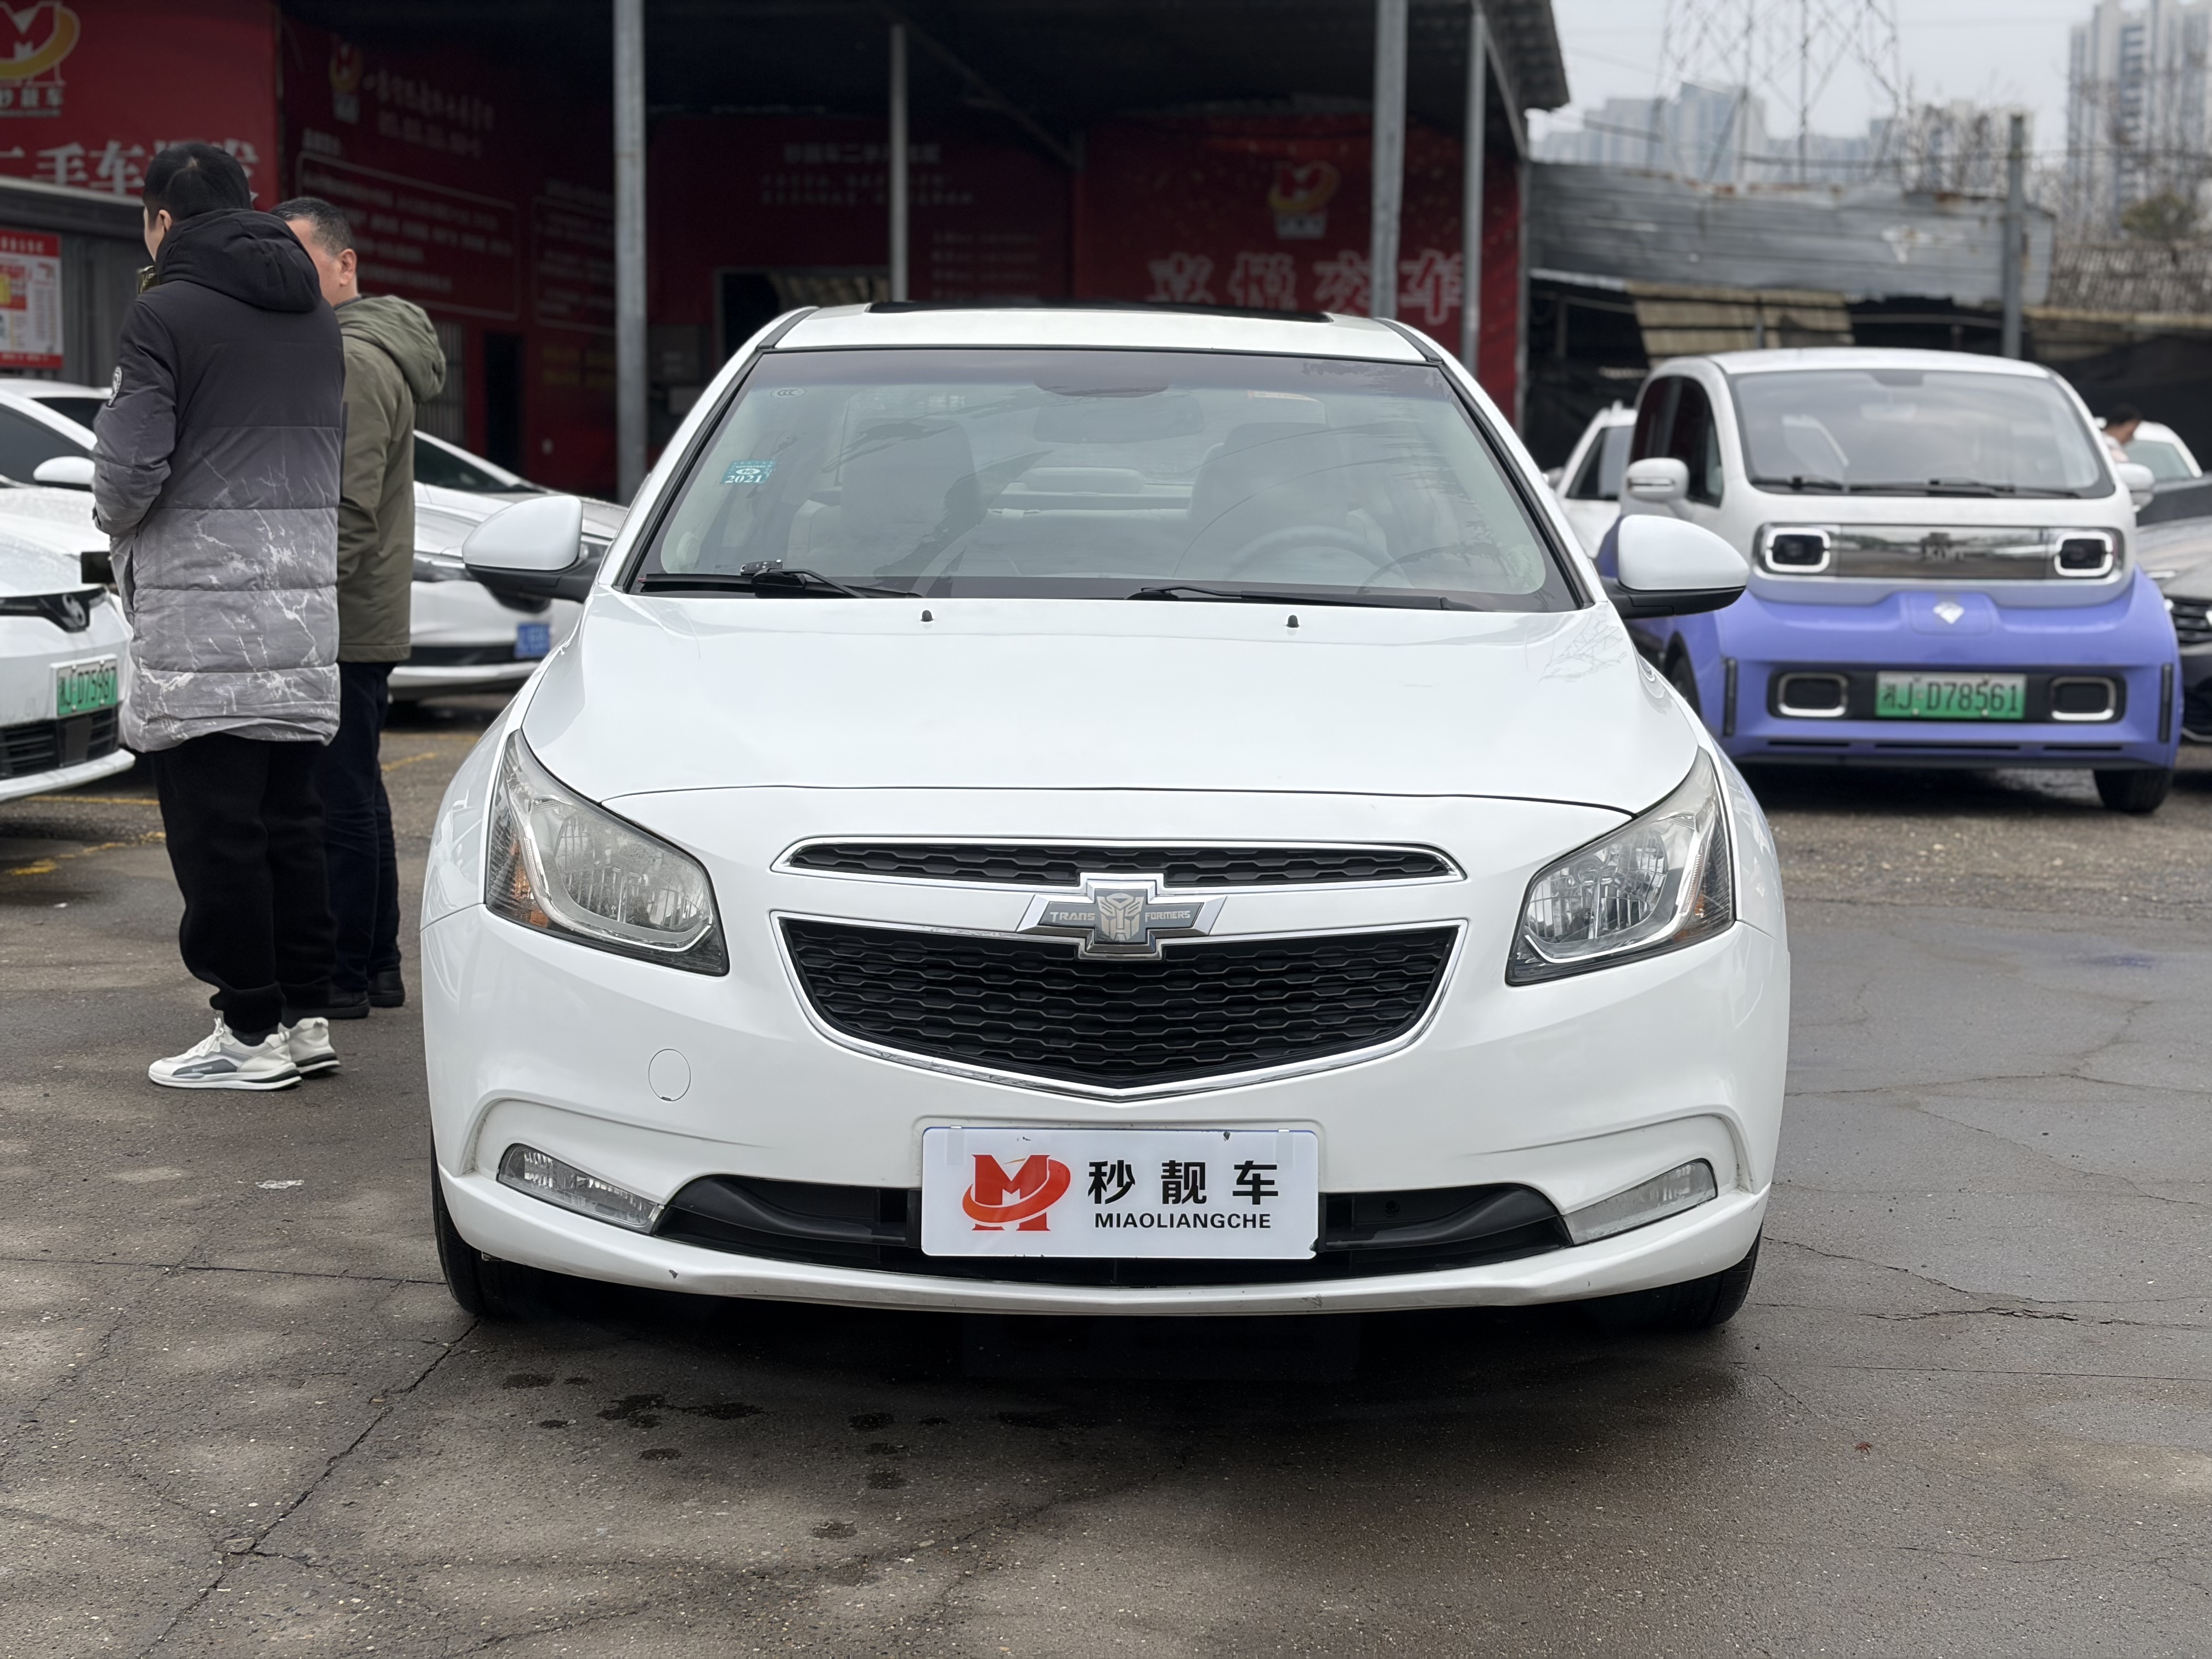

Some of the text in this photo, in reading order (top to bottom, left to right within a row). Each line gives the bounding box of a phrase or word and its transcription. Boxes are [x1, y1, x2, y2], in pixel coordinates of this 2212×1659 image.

[724, 475, 763, 483] 2021
[1050, 910, 1190, 923] TRANS FORMERS
[1088, 1160, 1279, 1205] 秒靓车
[1094, 1212, 1271, 1229] MIAOLIANGCHE
